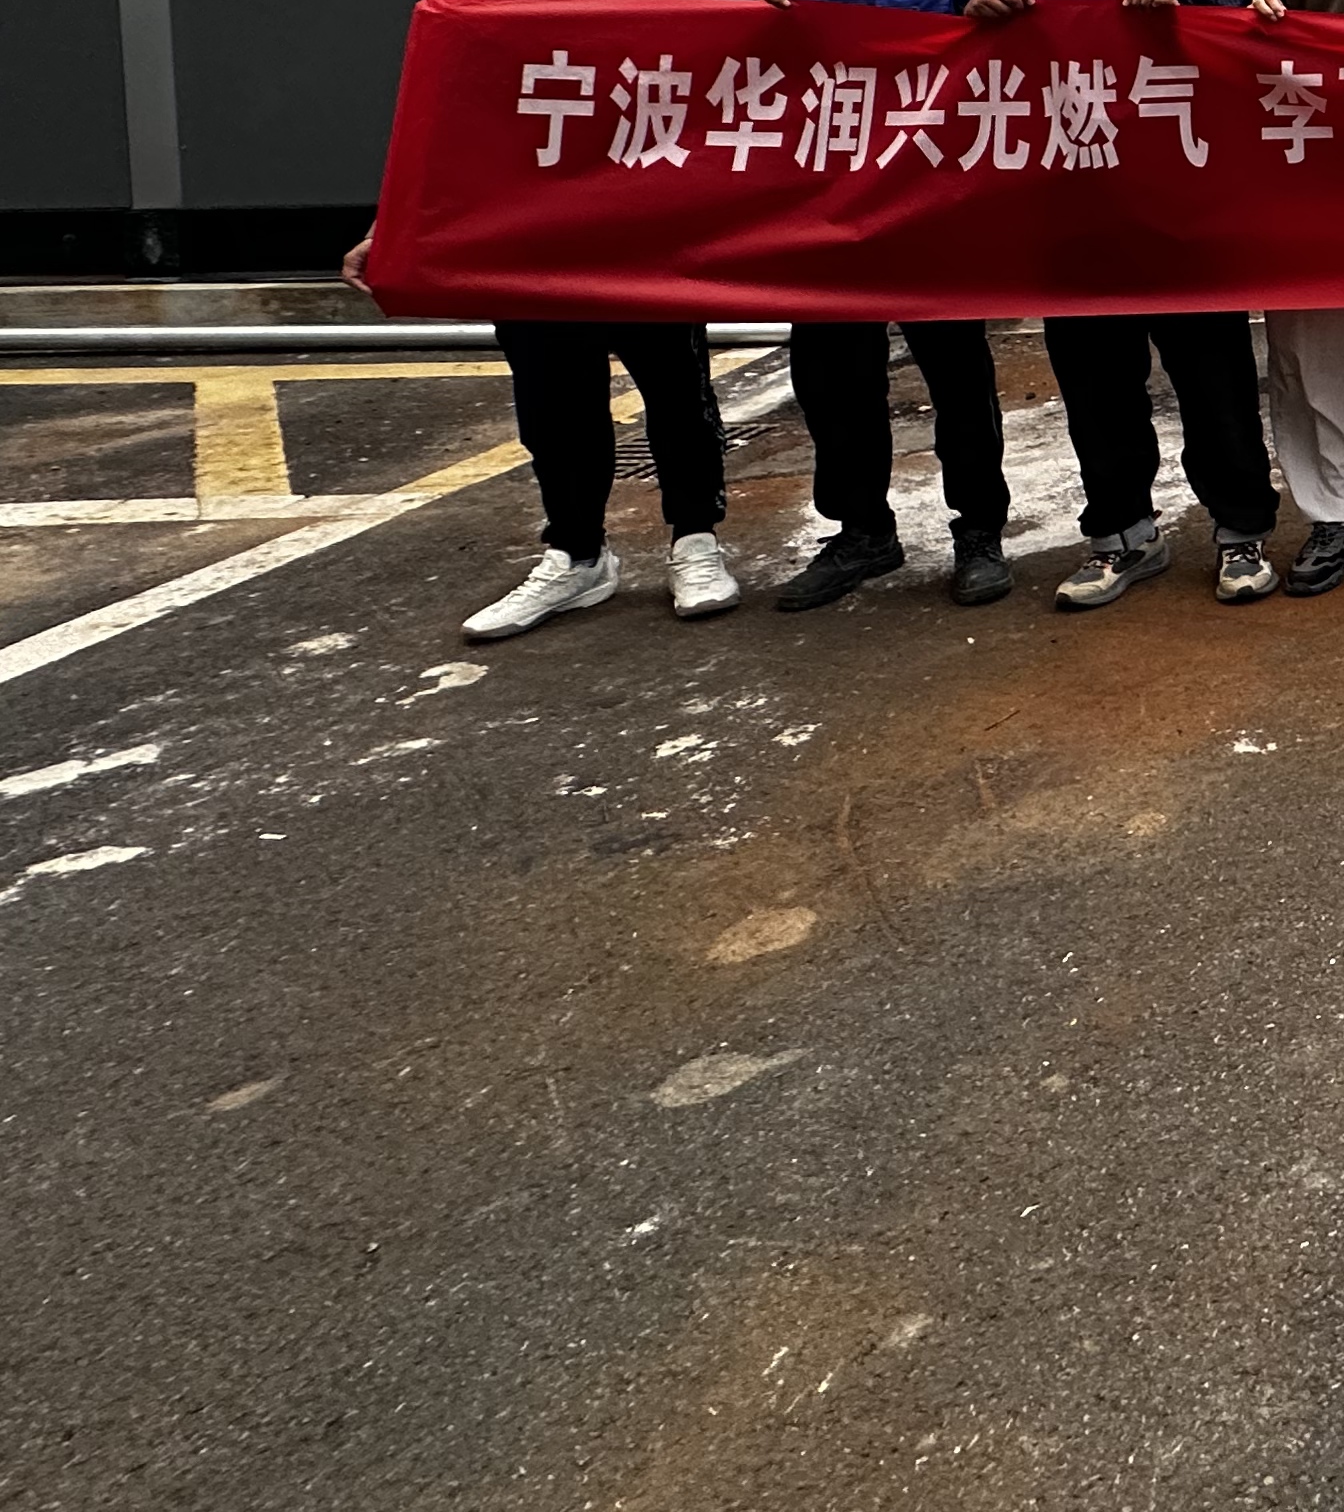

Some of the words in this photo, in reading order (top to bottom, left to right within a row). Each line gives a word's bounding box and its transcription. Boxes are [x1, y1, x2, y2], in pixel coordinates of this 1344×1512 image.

[515, 50, 1209, 172] 宁波华润兴光燃气
